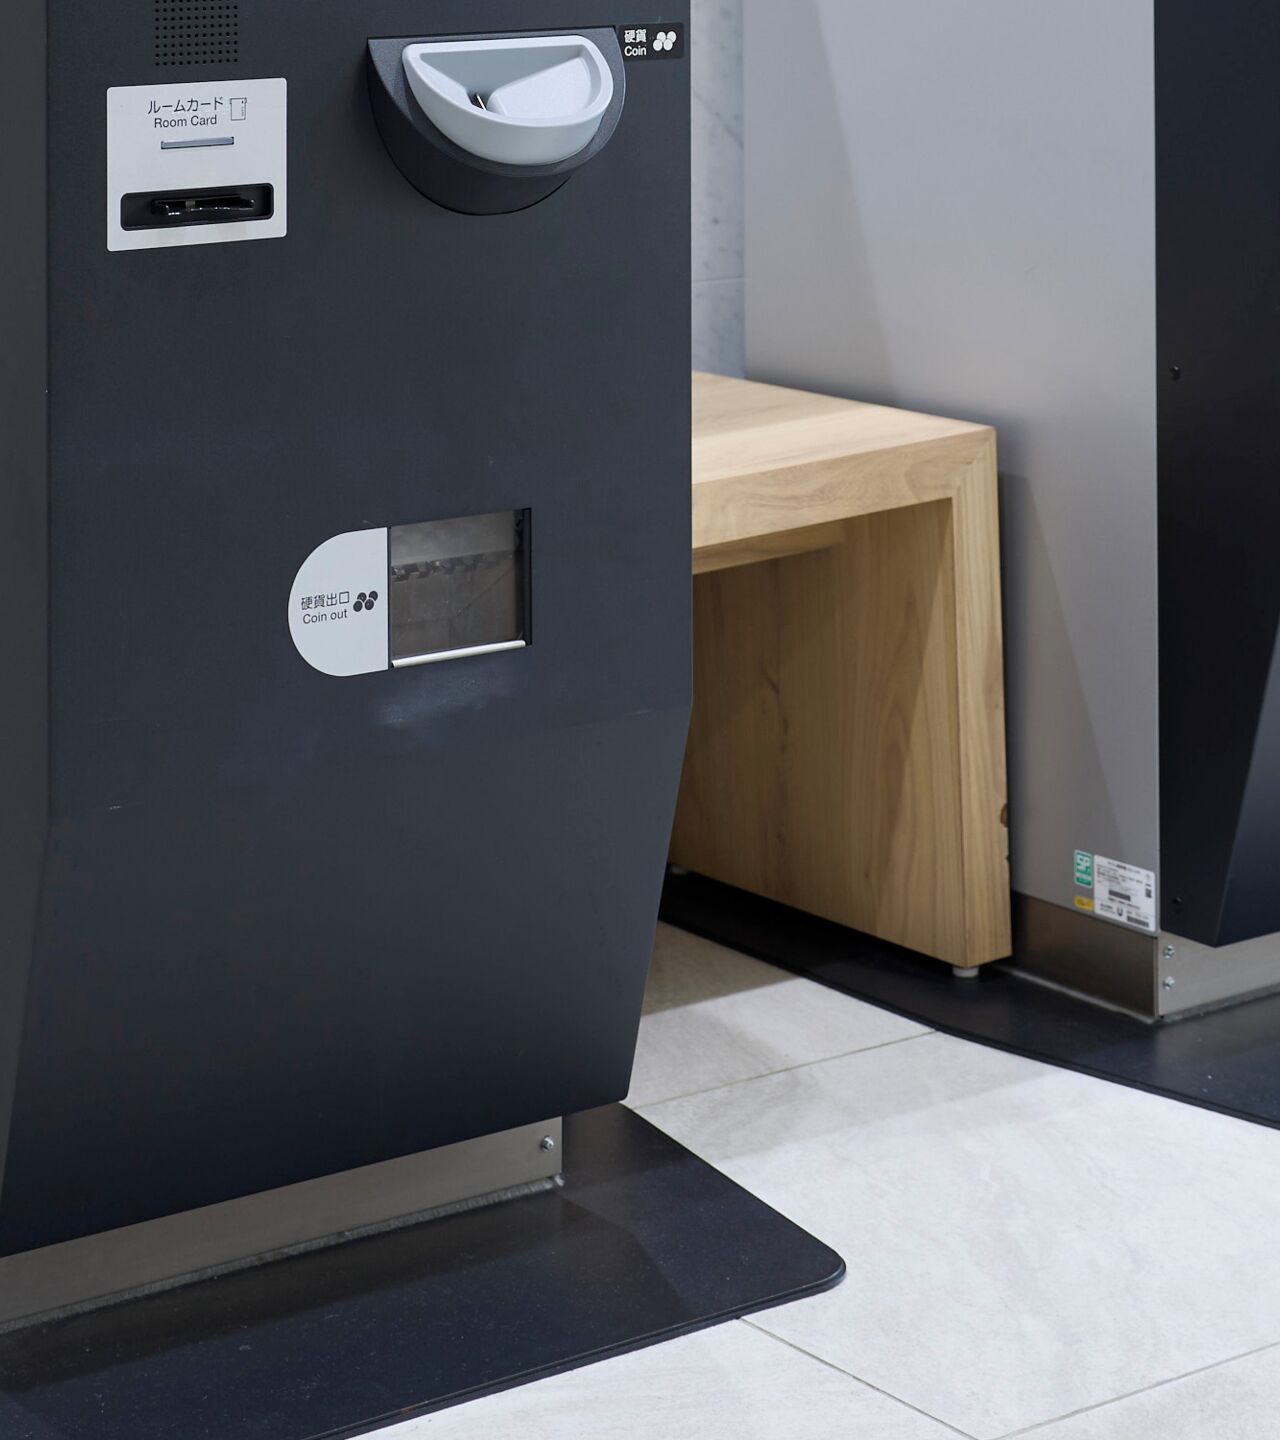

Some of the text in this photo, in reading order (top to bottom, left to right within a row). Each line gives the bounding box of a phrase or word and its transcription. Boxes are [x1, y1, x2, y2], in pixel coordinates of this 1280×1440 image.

[624, 45, 647, 57] Coin
[147, 96, 224, 115] ルームカード
[154, 115, 218, 129] Room Card
[300, 591, 350, 611] 硬貨出口
[302, 608, 348, 625] Coin out
